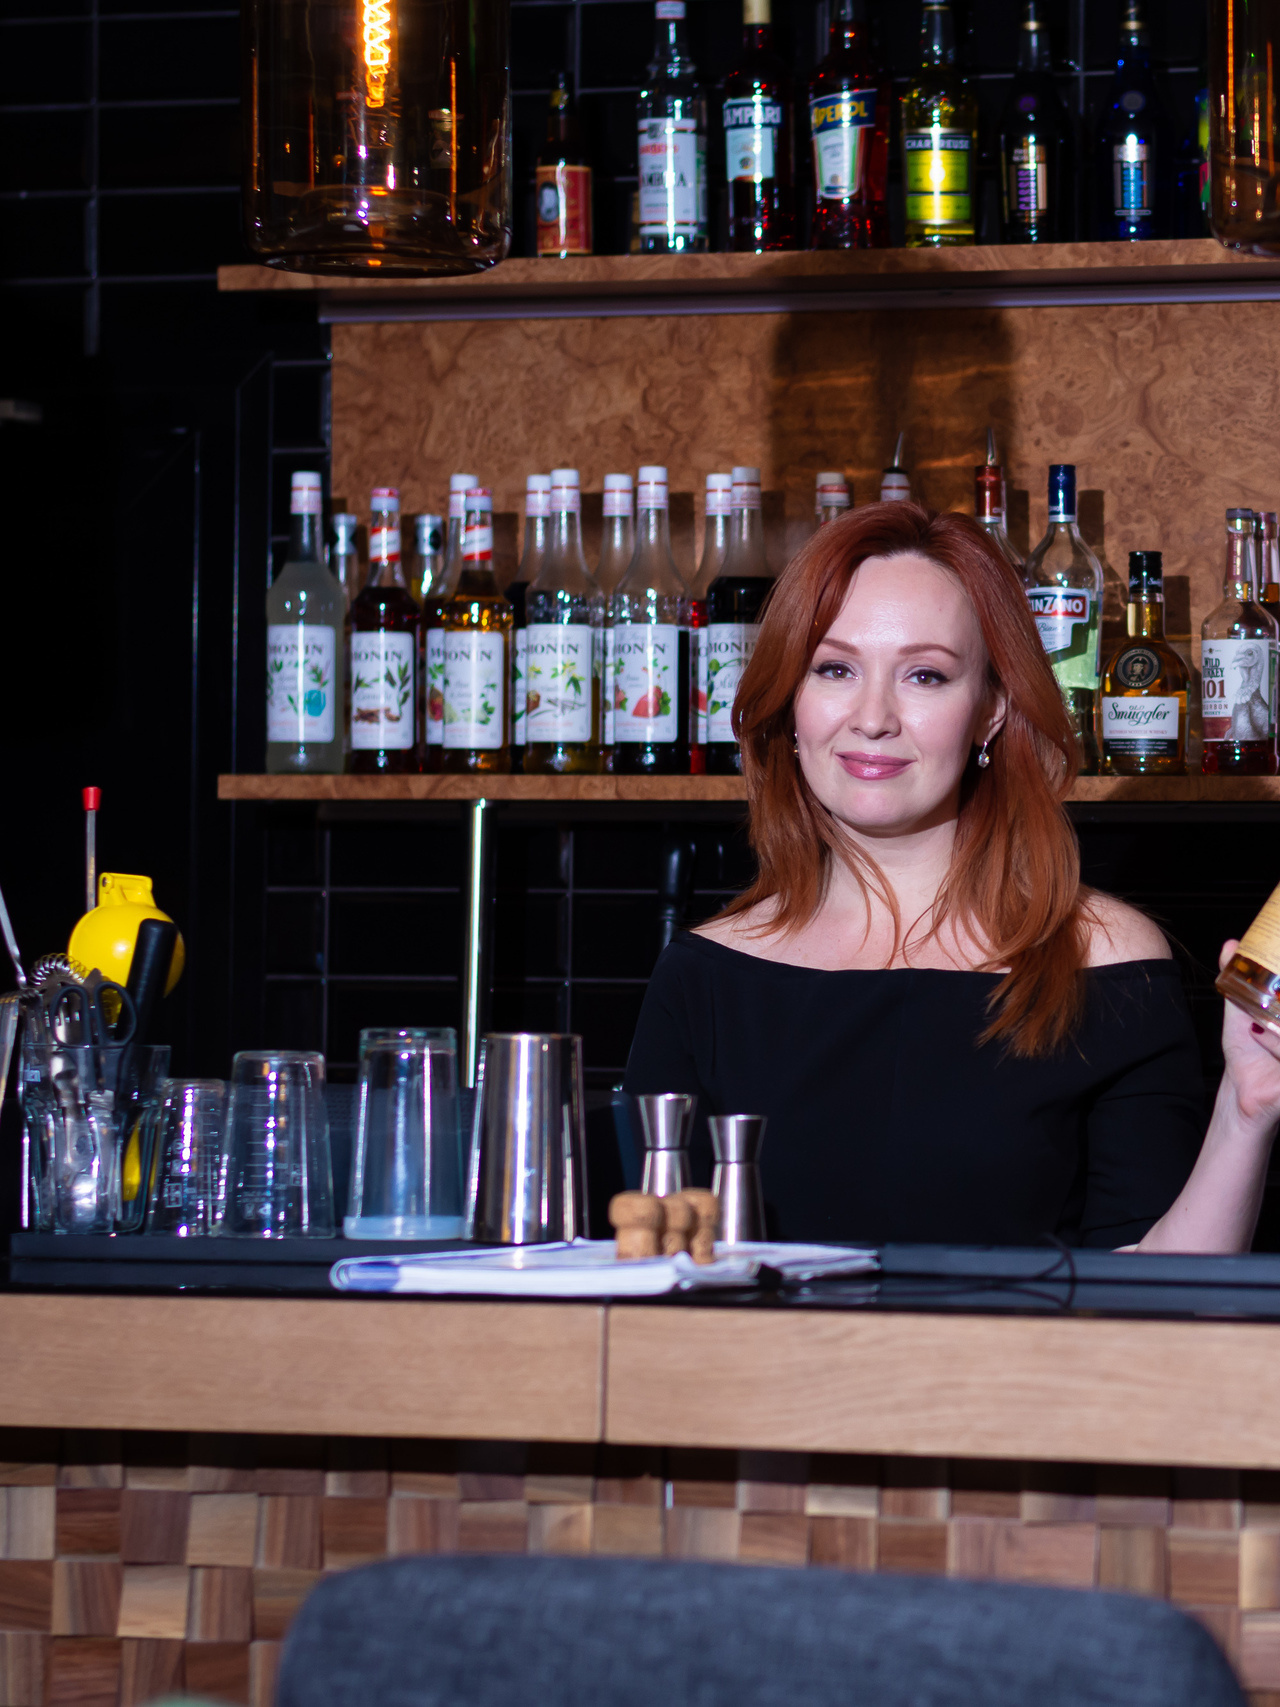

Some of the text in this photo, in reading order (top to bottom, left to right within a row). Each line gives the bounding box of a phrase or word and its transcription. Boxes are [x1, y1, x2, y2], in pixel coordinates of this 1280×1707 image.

[905, 139, 970, 149] CHARREUSE
[1018, 170, 1037, 210] CASSIS
[1030, 597, 1083, 614] INZANO
[1202, 679, 1226, 699] 101
[1107, 701, 1171, 727] Smuggler
